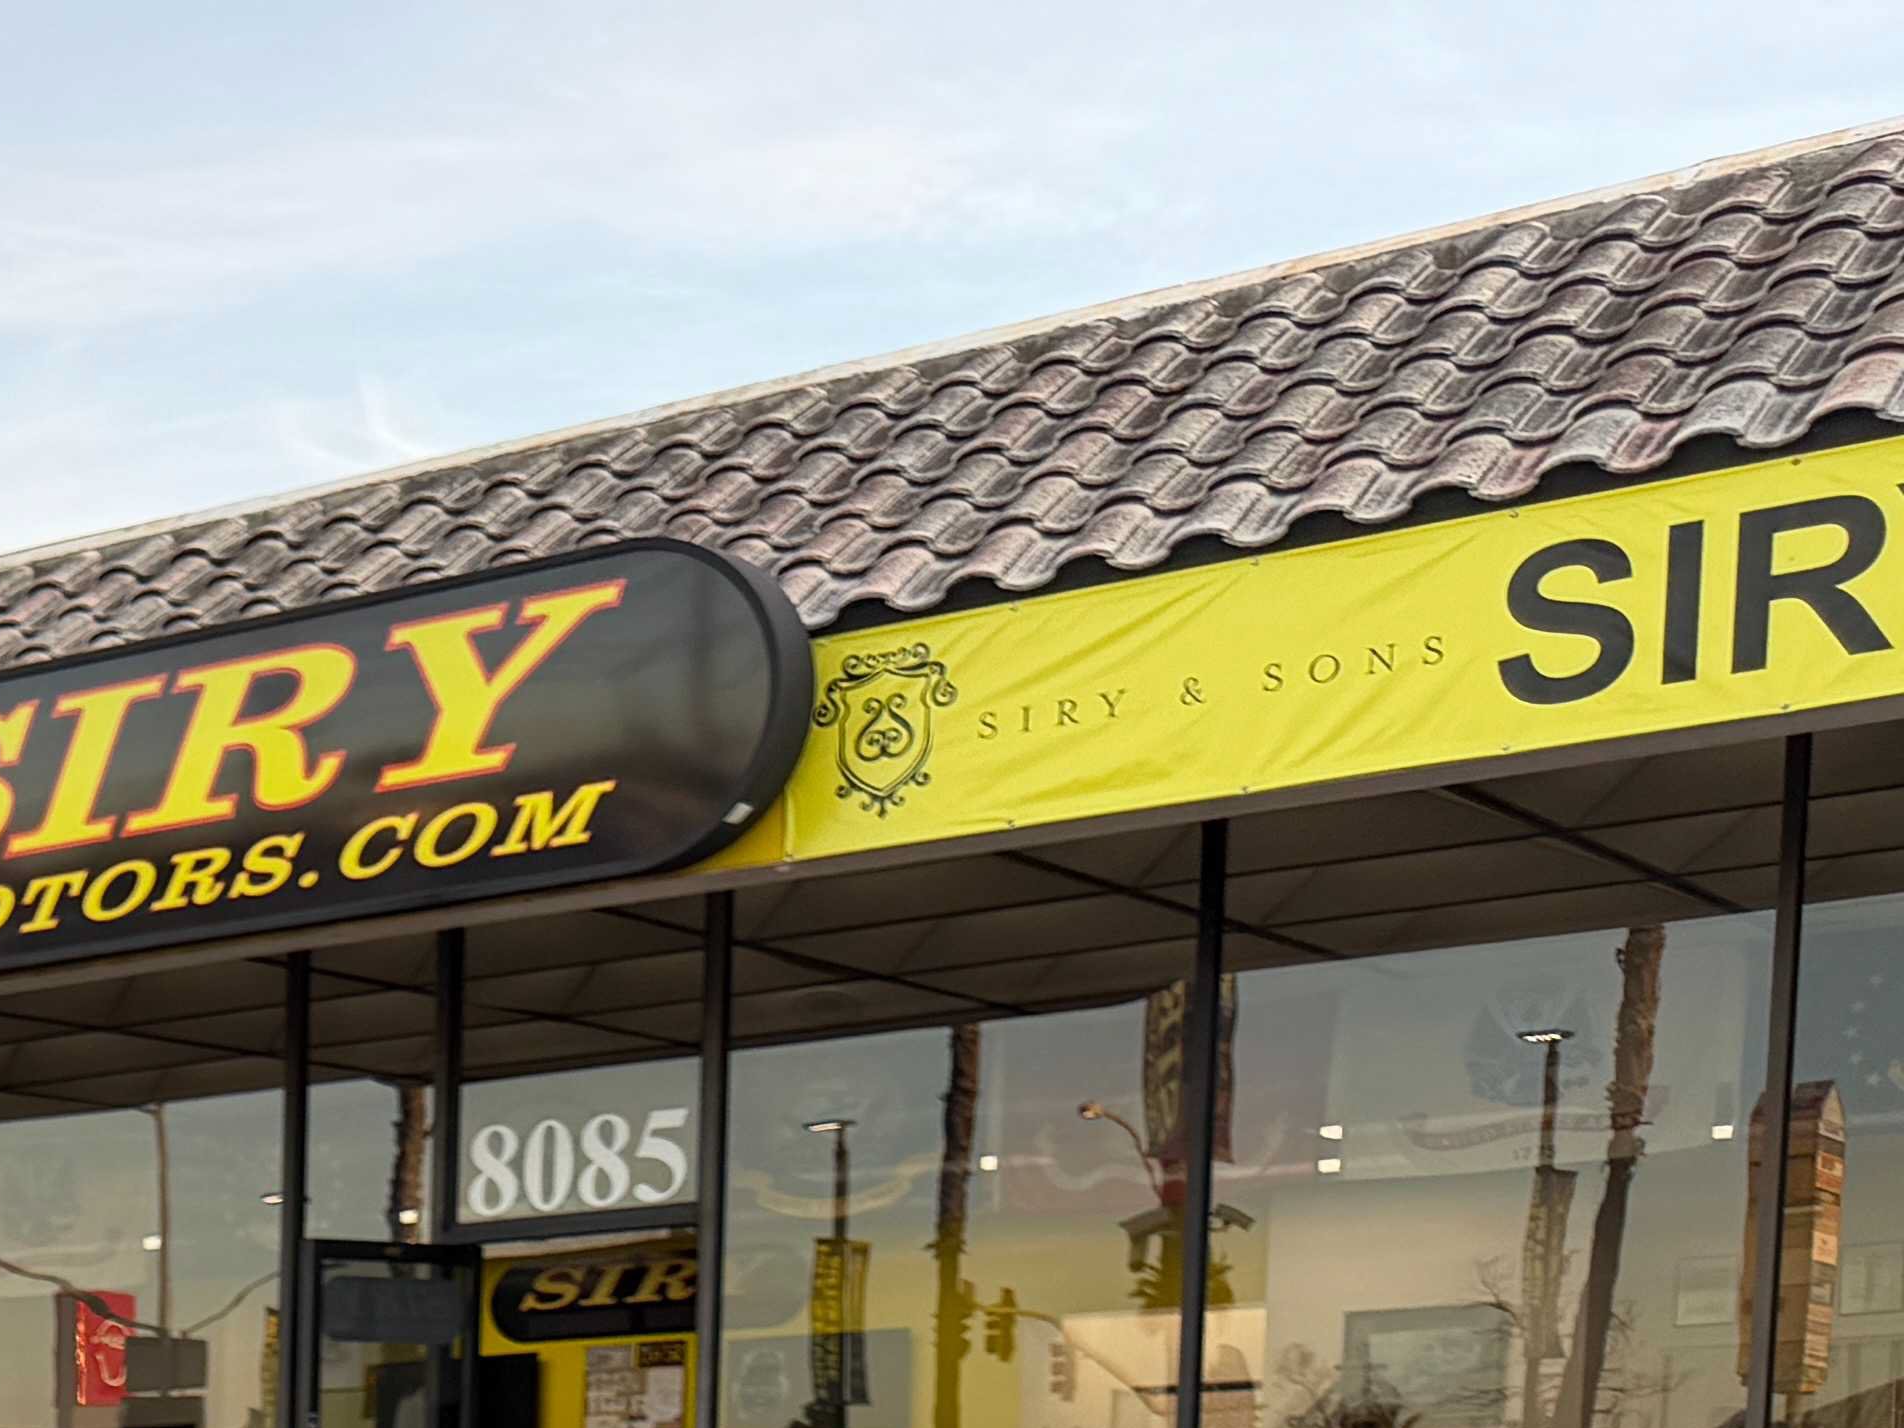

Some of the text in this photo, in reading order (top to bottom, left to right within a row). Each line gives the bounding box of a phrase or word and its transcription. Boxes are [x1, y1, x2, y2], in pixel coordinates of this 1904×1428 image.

[1496, 483, 1904, 708] SIR
[978, 634, 1450, 740] SIRY & SONS
[466, 1108, 690, 1217] 8085
